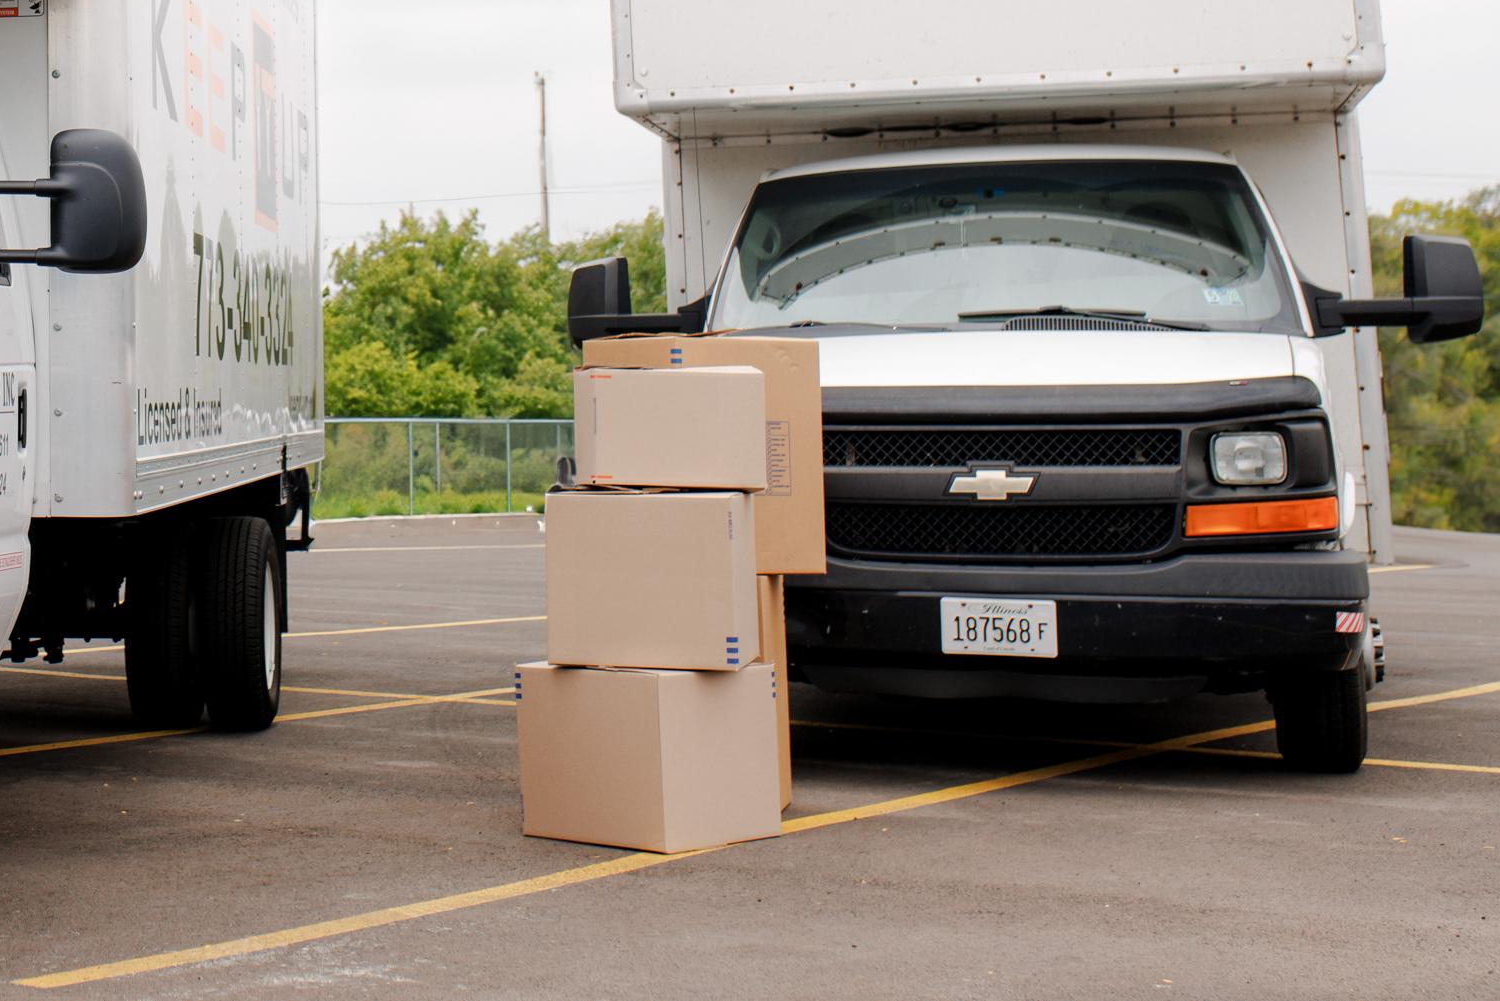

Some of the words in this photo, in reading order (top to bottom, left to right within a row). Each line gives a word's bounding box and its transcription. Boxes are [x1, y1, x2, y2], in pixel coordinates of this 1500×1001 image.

[281, 92, 310, 206] UP
[193, 233, 294, 367] 773-340-3324
[3, 371, 15, 408] INC
[137, 387, 182, 446] Licensed
[185, 387, 191, 440] &
[193, 387, 223, 438] Insured
[953, 616, 1031, 644] 187568
[1038, 622, 1048, 640] F
[968, 603, 1028, 615] Illinois
